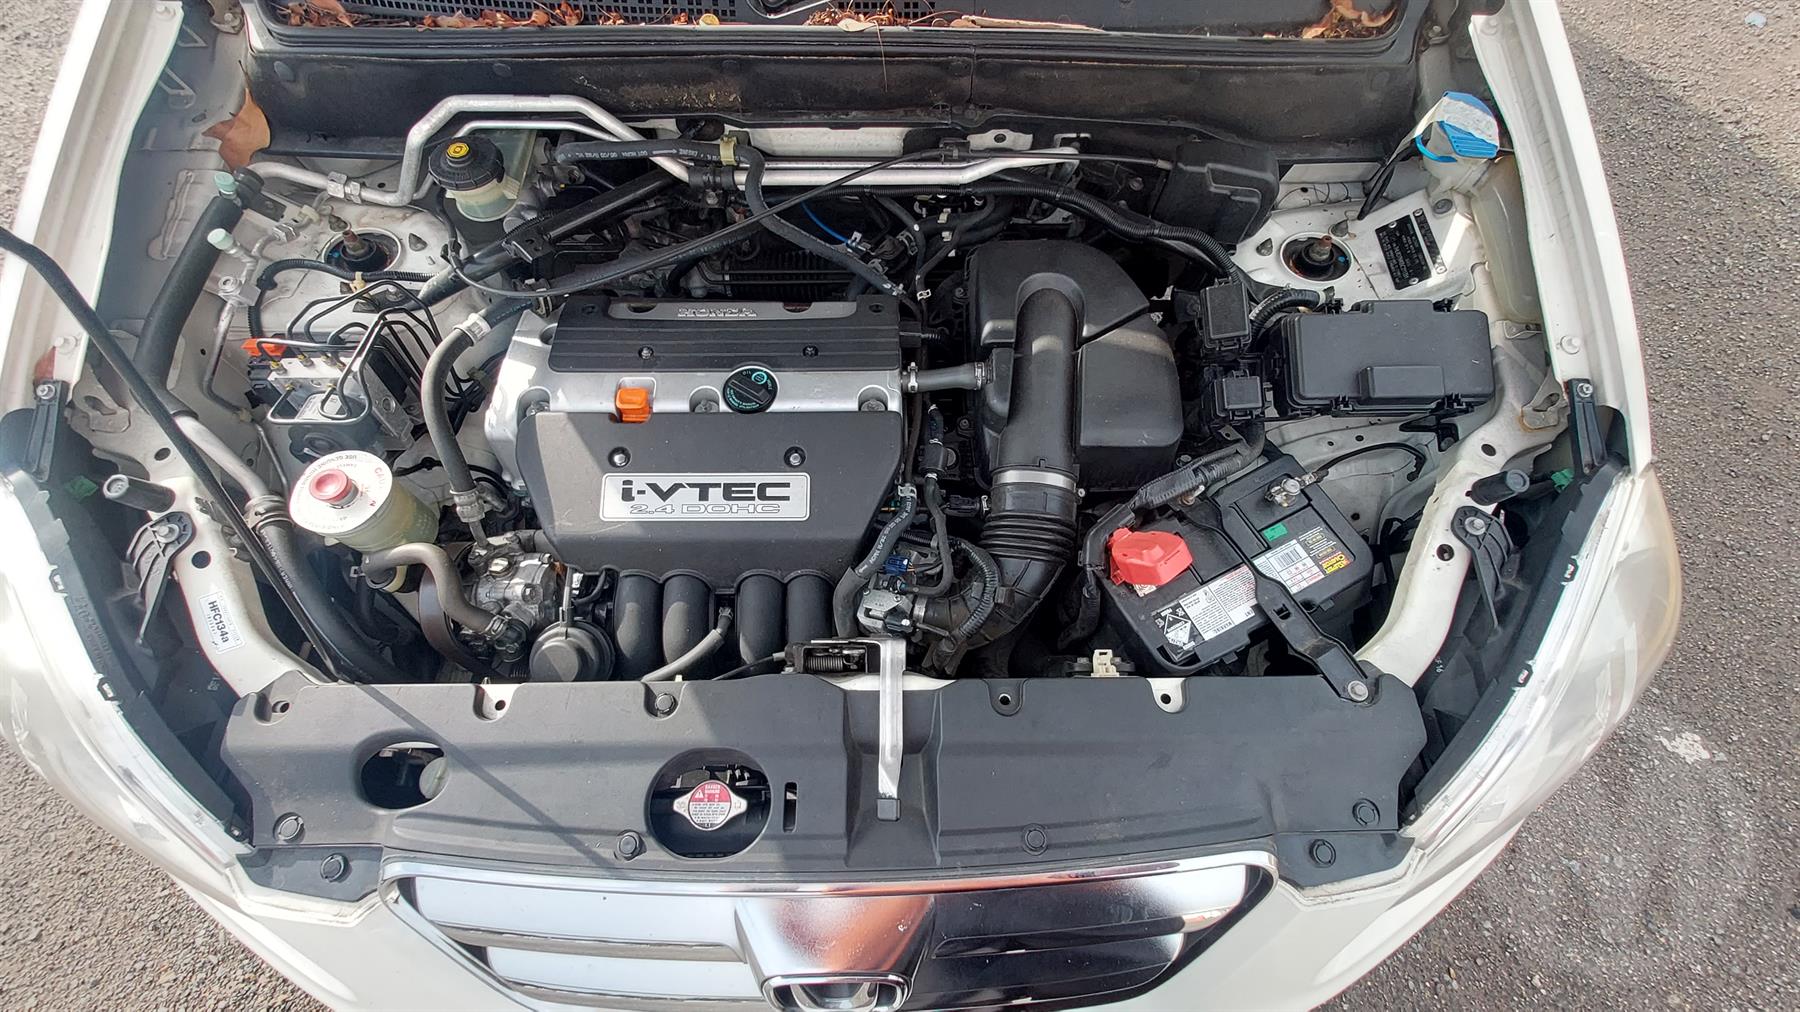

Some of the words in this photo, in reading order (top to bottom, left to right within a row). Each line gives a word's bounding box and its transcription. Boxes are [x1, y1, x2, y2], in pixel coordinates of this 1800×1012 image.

[621, 479, 791, 503] i-VTEC
[629, 503, 676, 515] 2.4
[680, 503, 781, 515] DOHC
[209, 601, 229, 643] HFC134a
